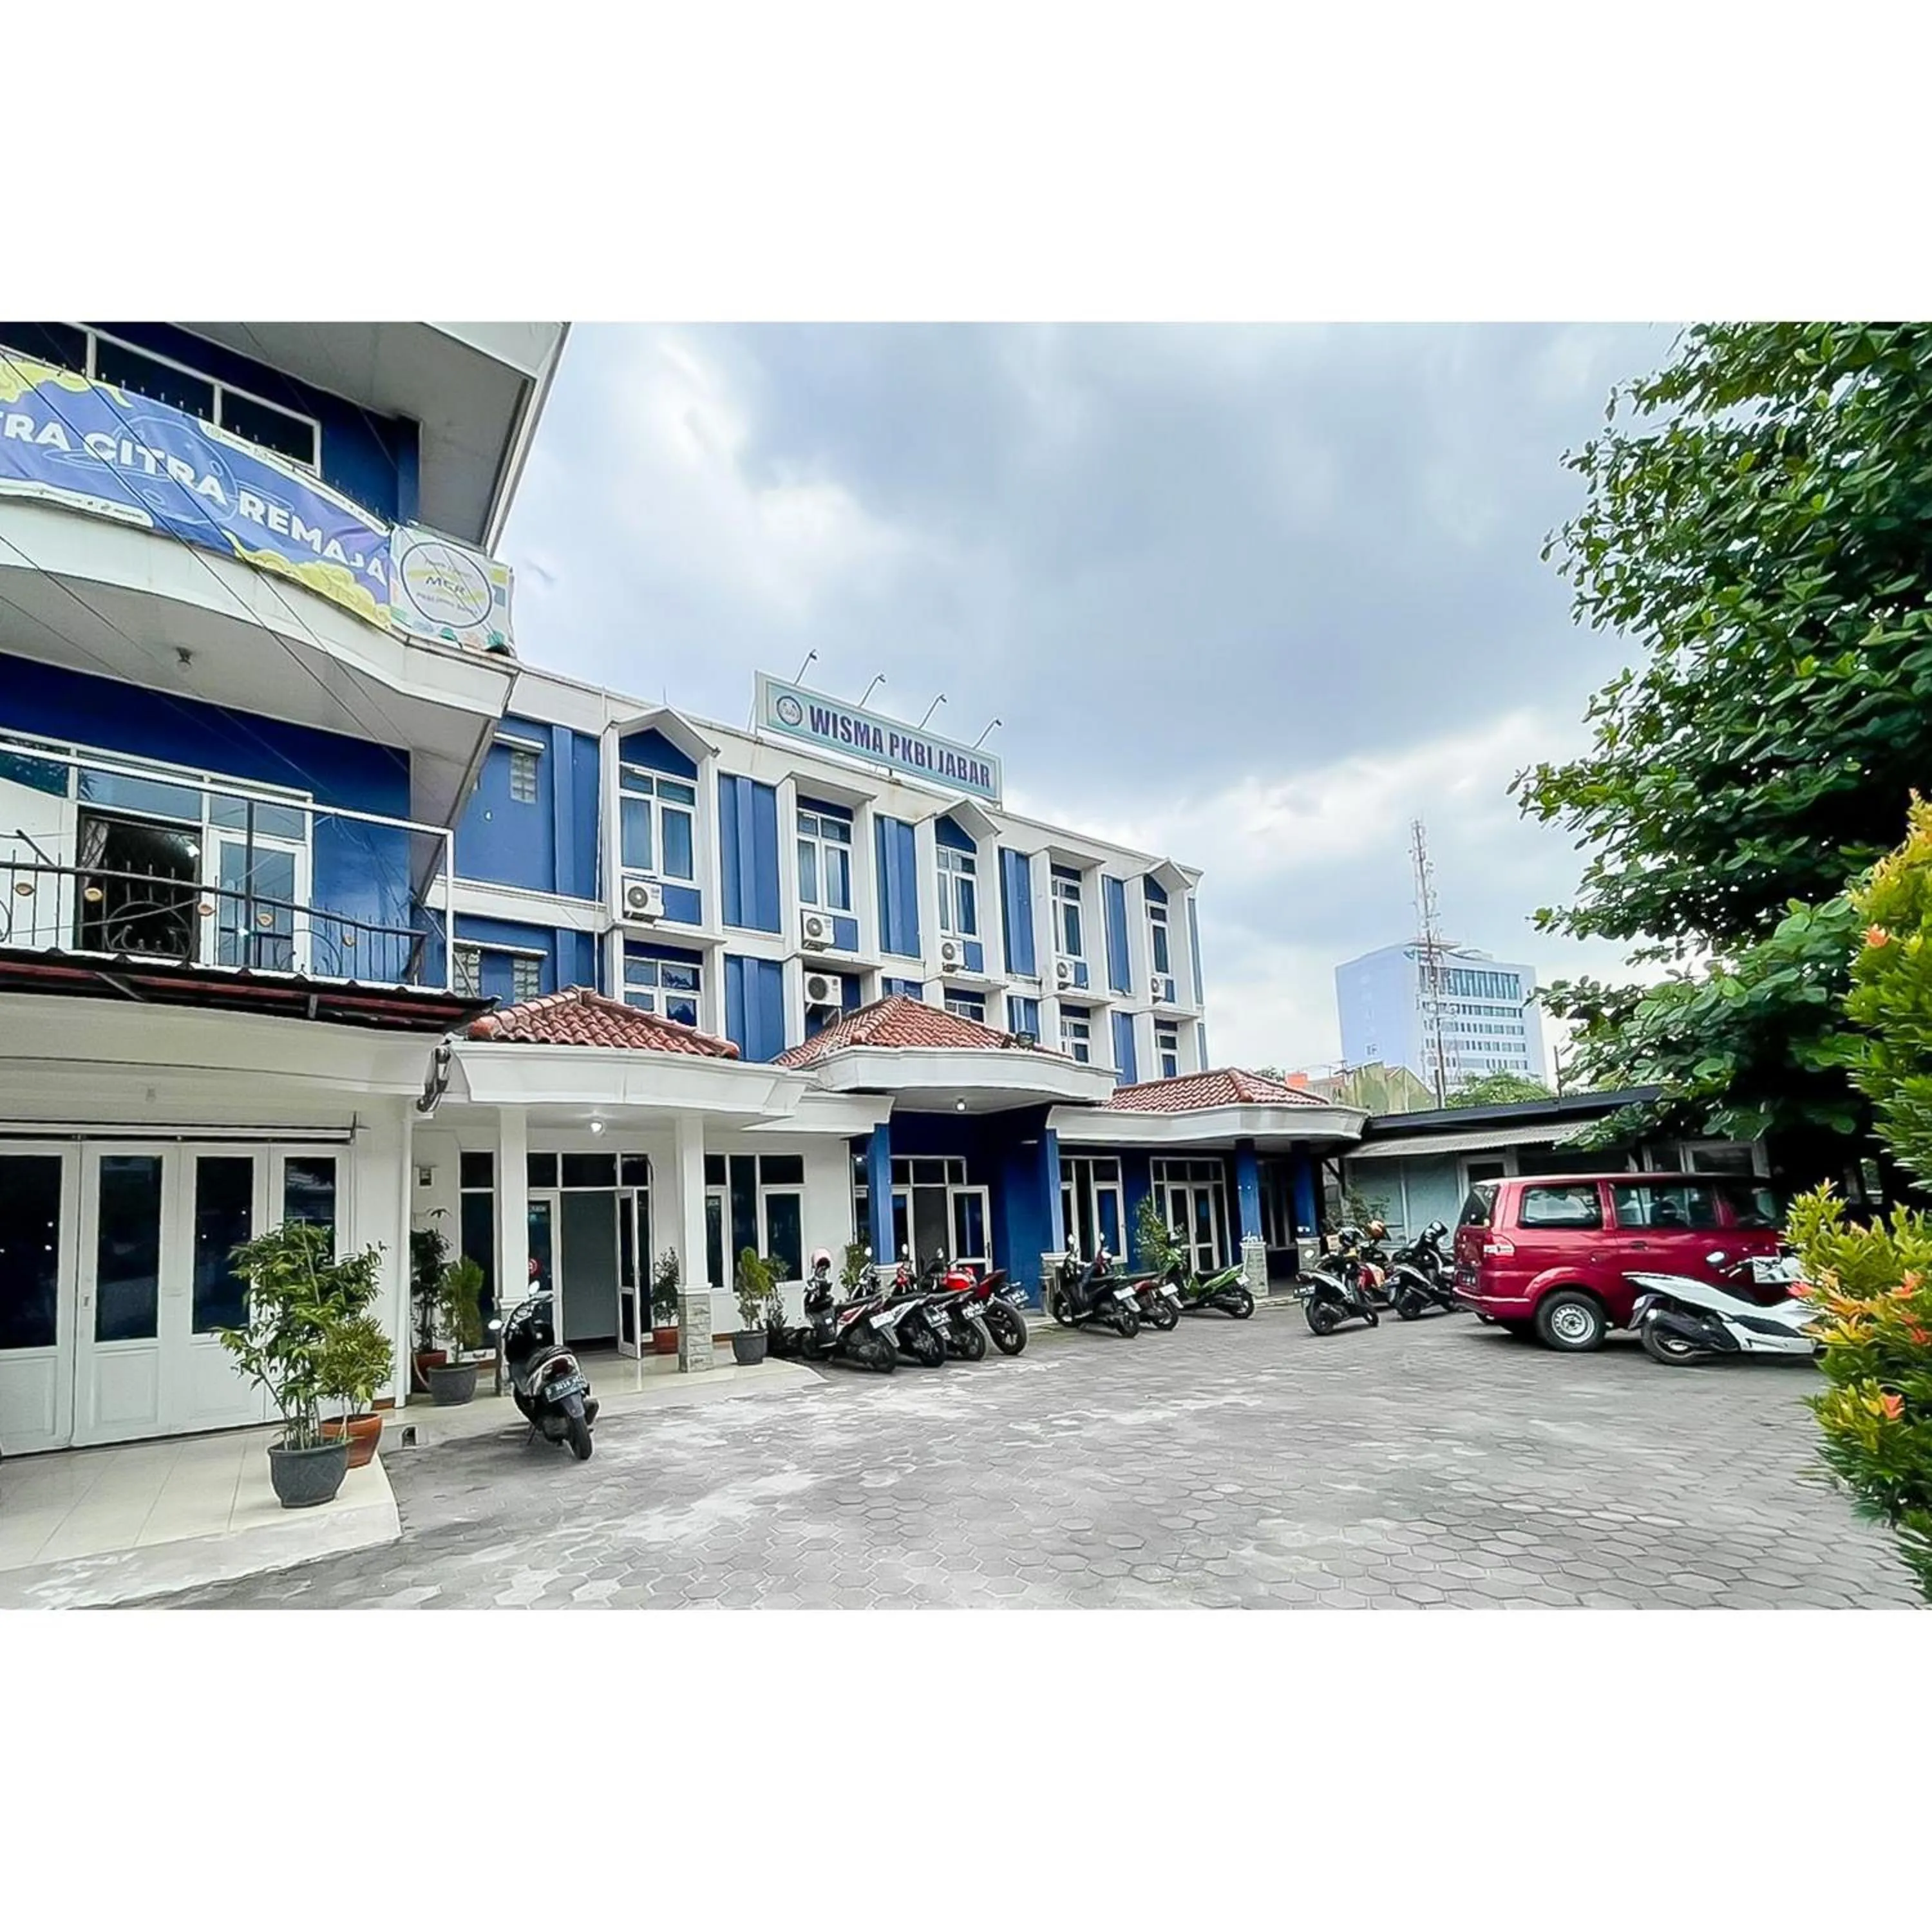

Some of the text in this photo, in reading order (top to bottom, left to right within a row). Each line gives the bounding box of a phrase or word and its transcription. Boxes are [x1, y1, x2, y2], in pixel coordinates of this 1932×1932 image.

[0, 411, 71, 451] RA
[82, 432, 227, 506] CITRA
[239, 490, 387, 587] REMAJA
[810, 705, 884, 754] WISMA
[889, 732, 933, 770] PKBI
[938, 750, 990, 789] JABAR
